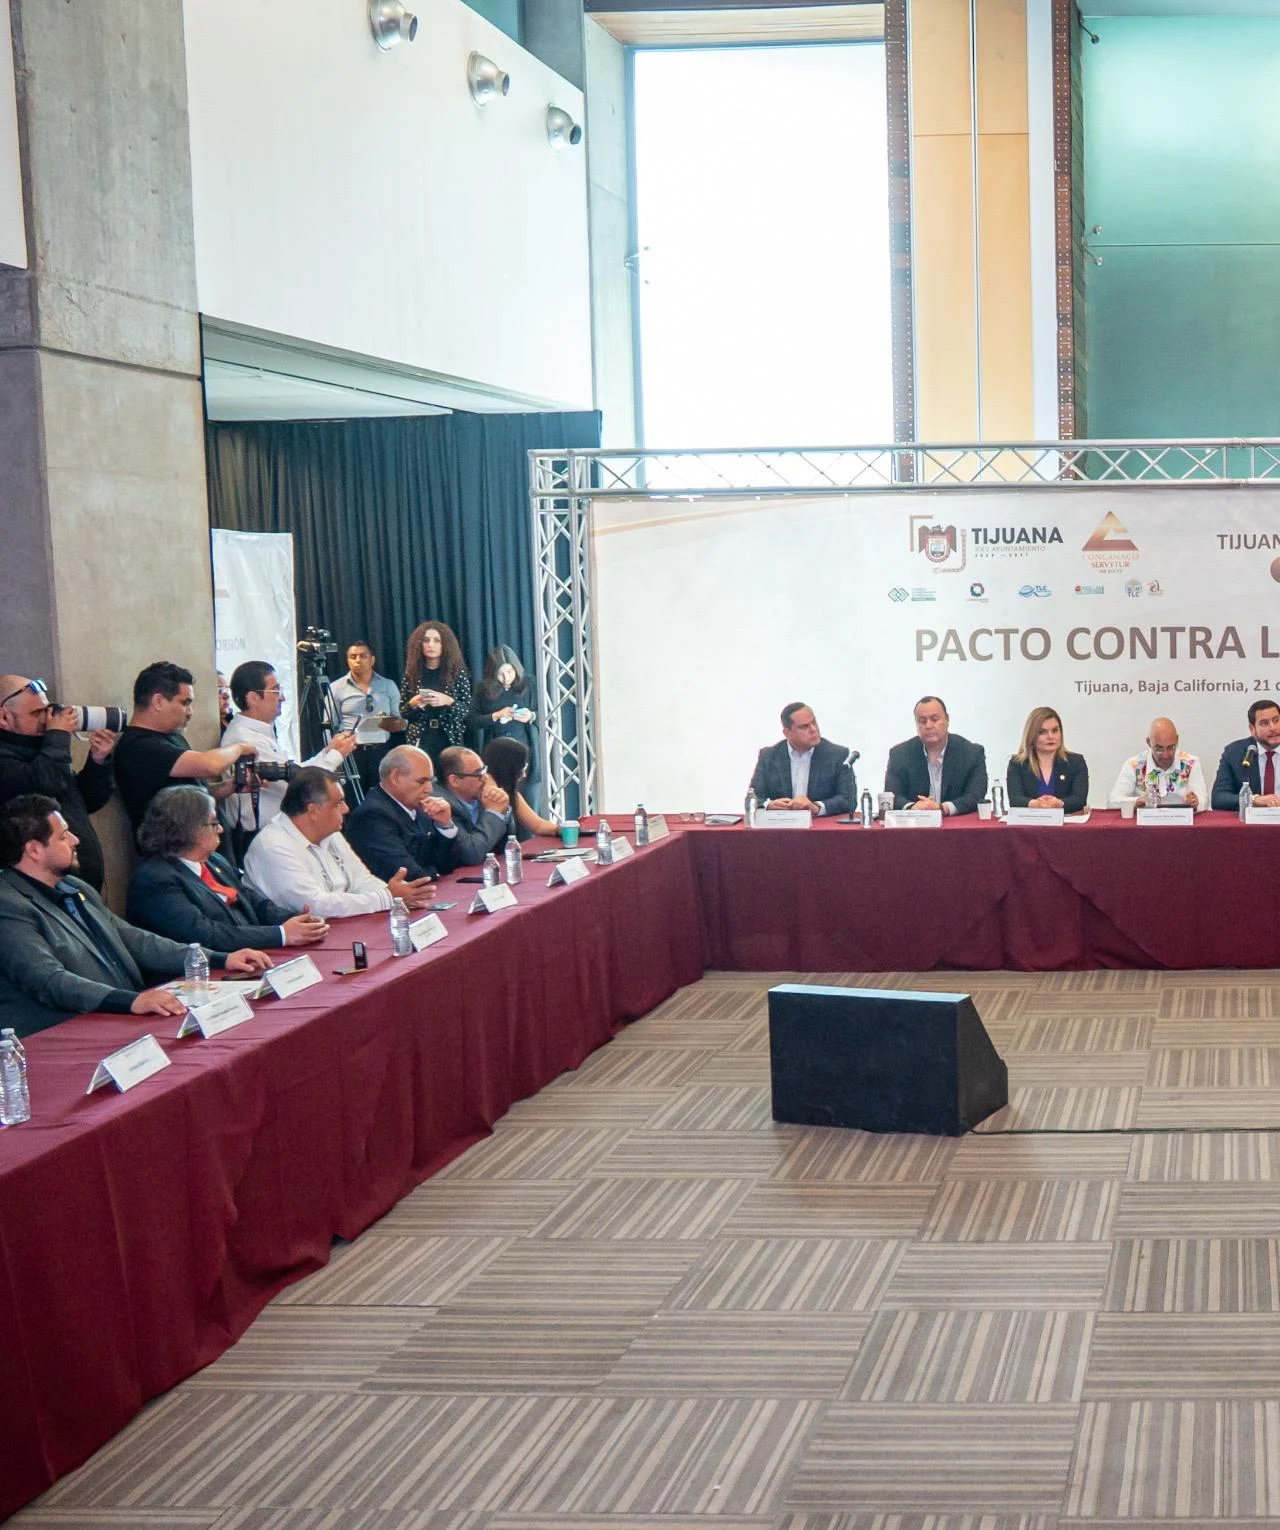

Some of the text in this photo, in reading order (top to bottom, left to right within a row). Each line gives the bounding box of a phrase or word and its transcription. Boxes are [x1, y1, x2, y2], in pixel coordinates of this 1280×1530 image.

[972, 527, 1064, 545] TIJUANA
[992, 545, 1046, 553] AYUNTAMIENTO
[916, 627, 1051, 661] PACTO
[1067, 626, 1247, 660] CONTRA
[1075, 680, 1133, 696] Tijuana,
[1139, 680, 1169, 696] Baja
[1174, 678, 1249, 694] California,
[1254, 679, 1270, 692] 21
